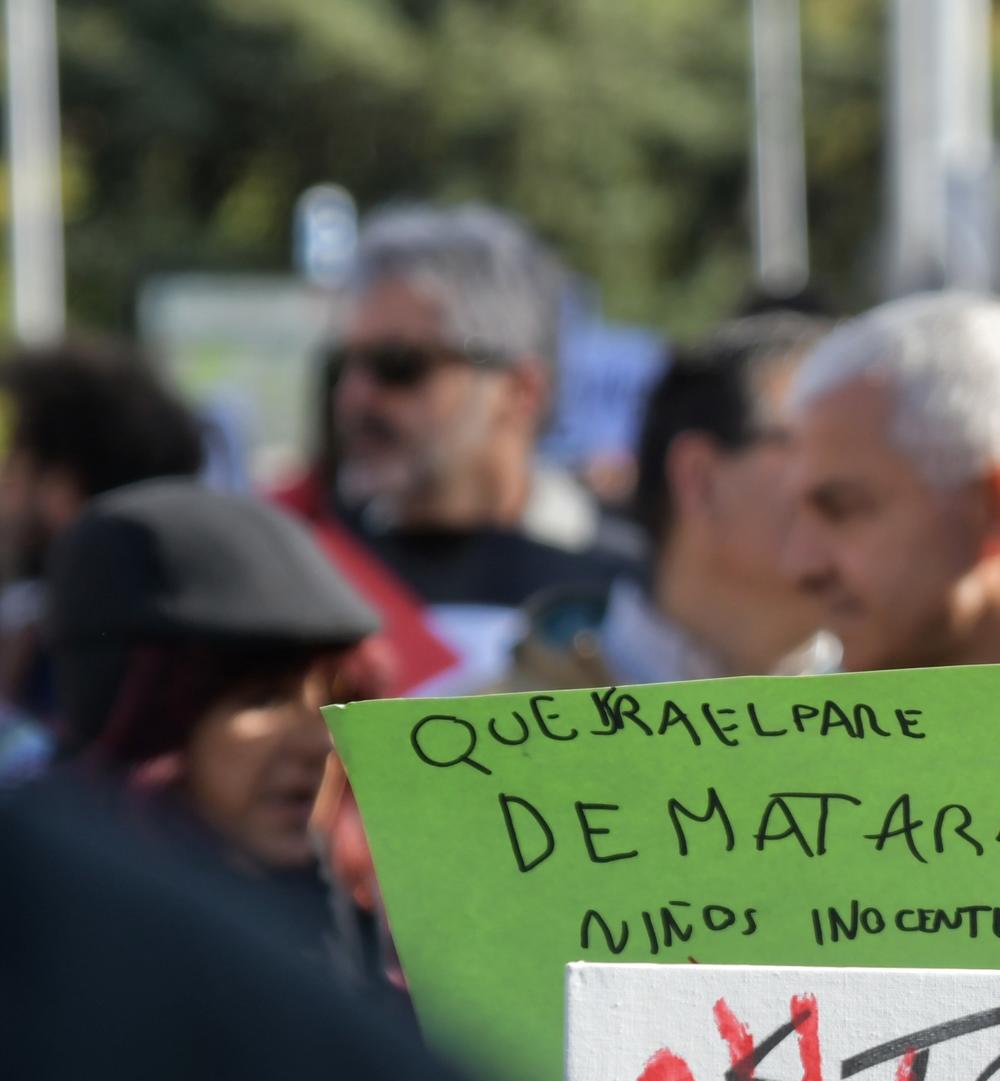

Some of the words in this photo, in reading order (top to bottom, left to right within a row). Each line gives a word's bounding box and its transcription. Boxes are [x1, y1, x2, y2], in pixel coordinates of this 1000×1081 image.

[410, 694, 579, 776] QUE
[498, 792, 639, 873] DE
[580, 900, 758, 956] NIÑOS
